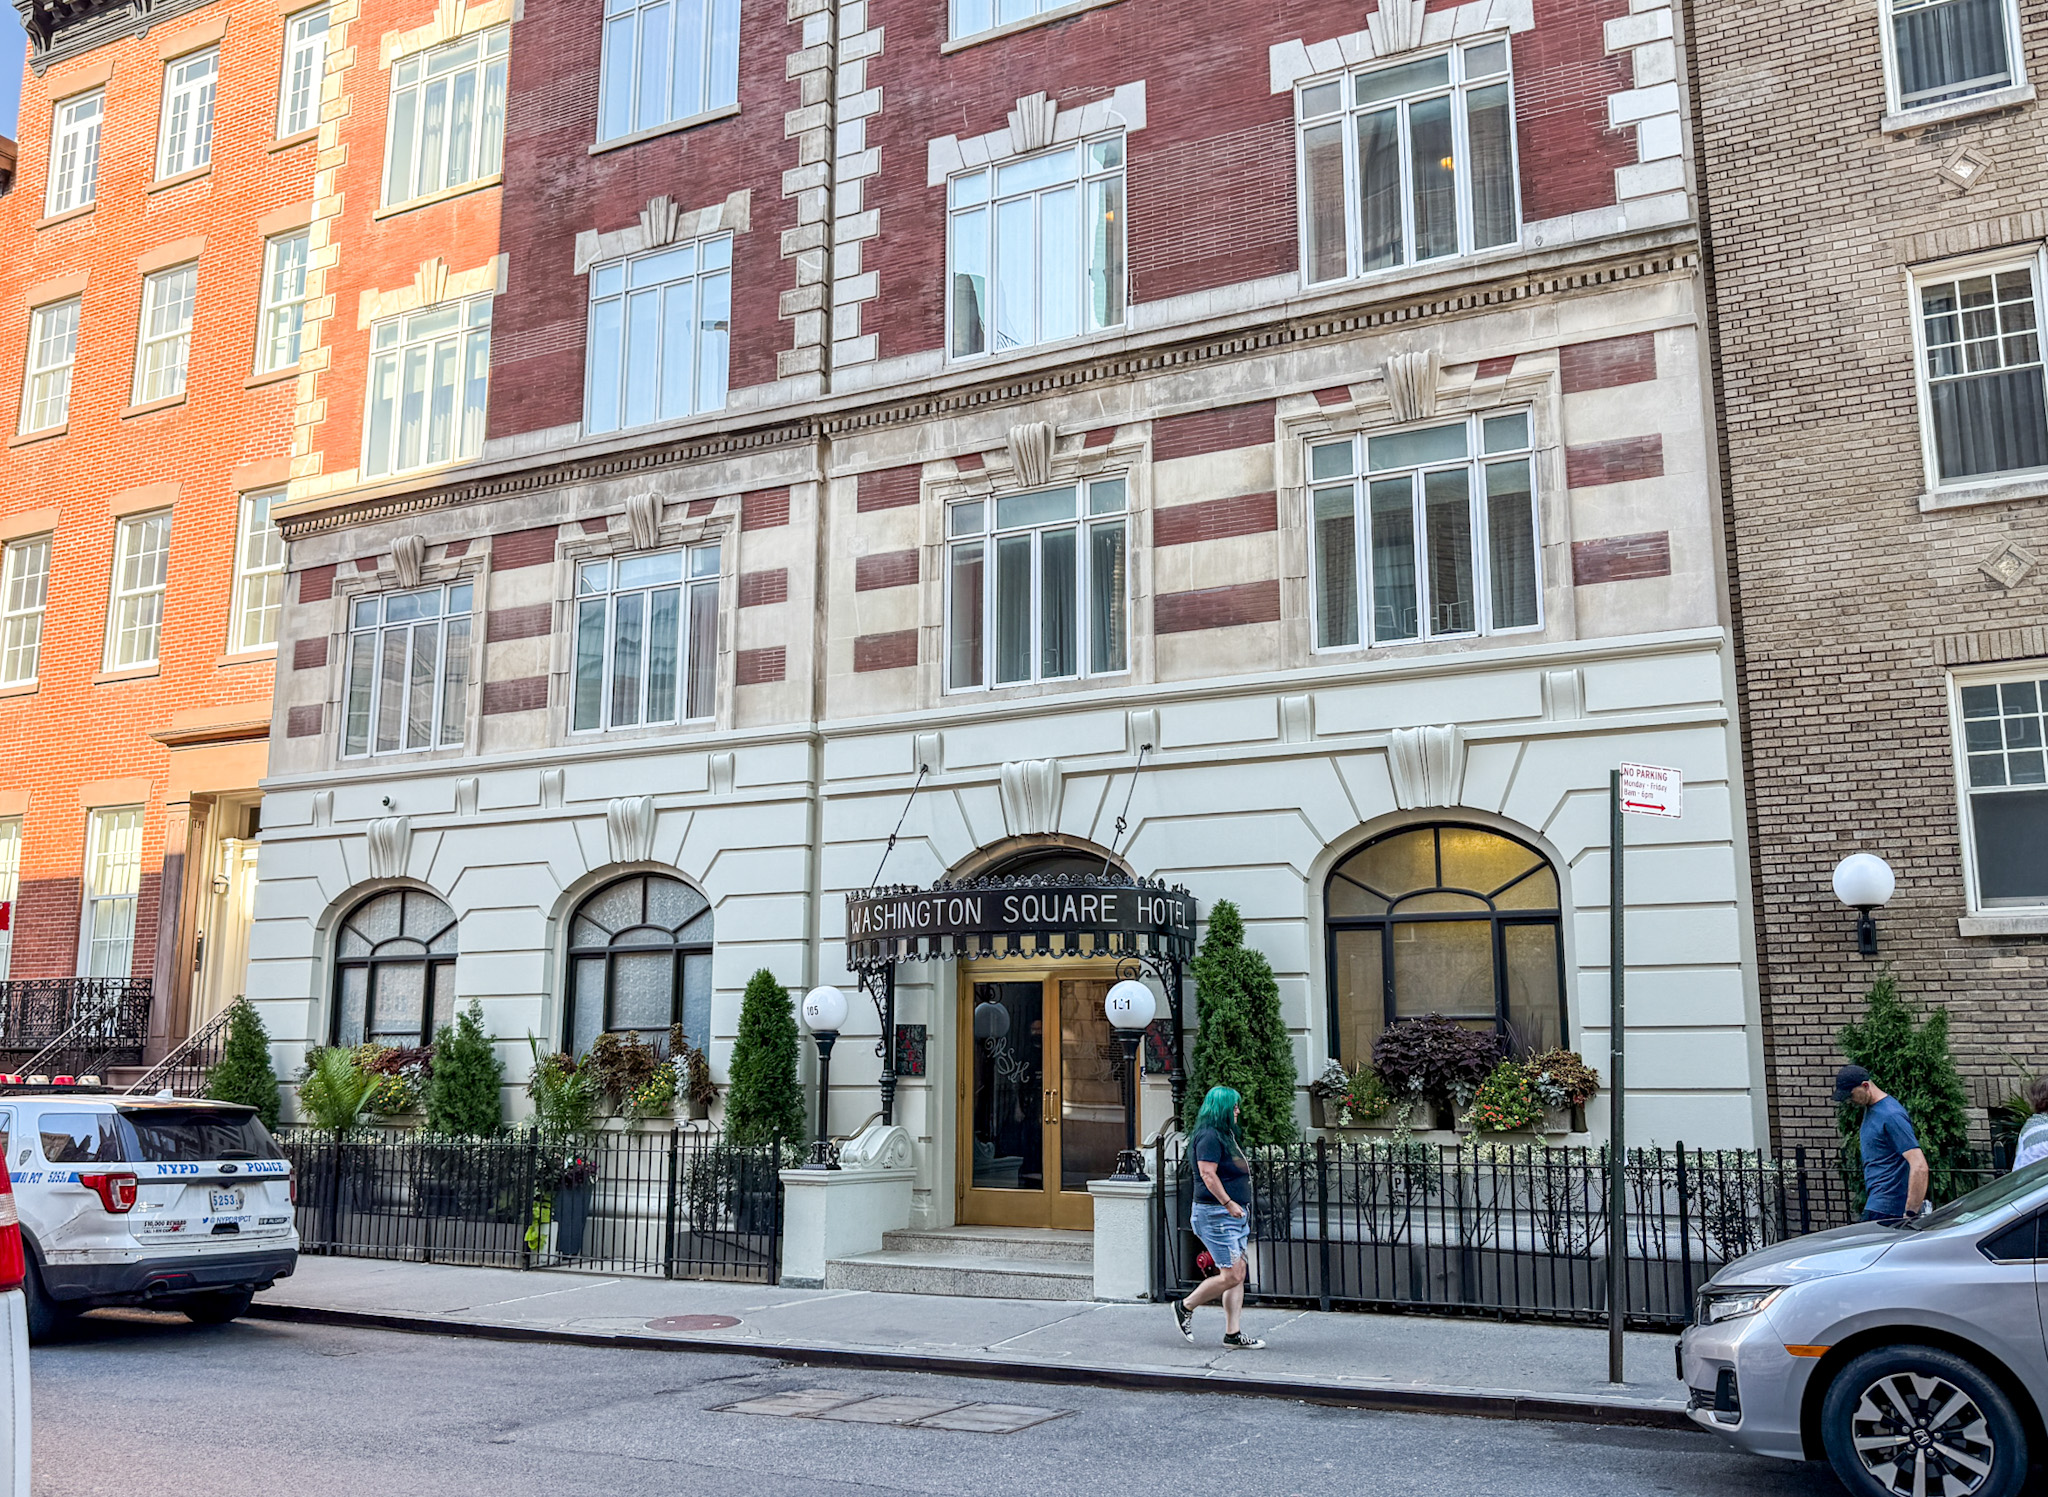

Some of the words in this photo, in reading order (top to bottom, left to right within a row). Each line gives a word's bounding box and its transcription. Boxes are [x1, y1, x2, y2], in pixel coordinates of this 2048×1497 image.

[1623, 767, 1634, 777] NO
[1636, 769, 1668, 781] PARKING
[1624, 779, 1645, 789] Monday
[1650, 782, 1667, 792] Friday
[1624, 788, 1636, 797] 8am
[1641, 790, 1654, 799] 6pm
[850, 896, 982, 935] WASHINGTON
[1002, 894, 1118, 924] SQUARE
[1137, 895, 1190, 930] HOTEL
[156, 1163, 200, 1175] NYPD
[245, 1162, 284, 1173] POLICE
[28, 1172, 43, 1184] PCT
[213, 1194, 235, 1206] 5253
